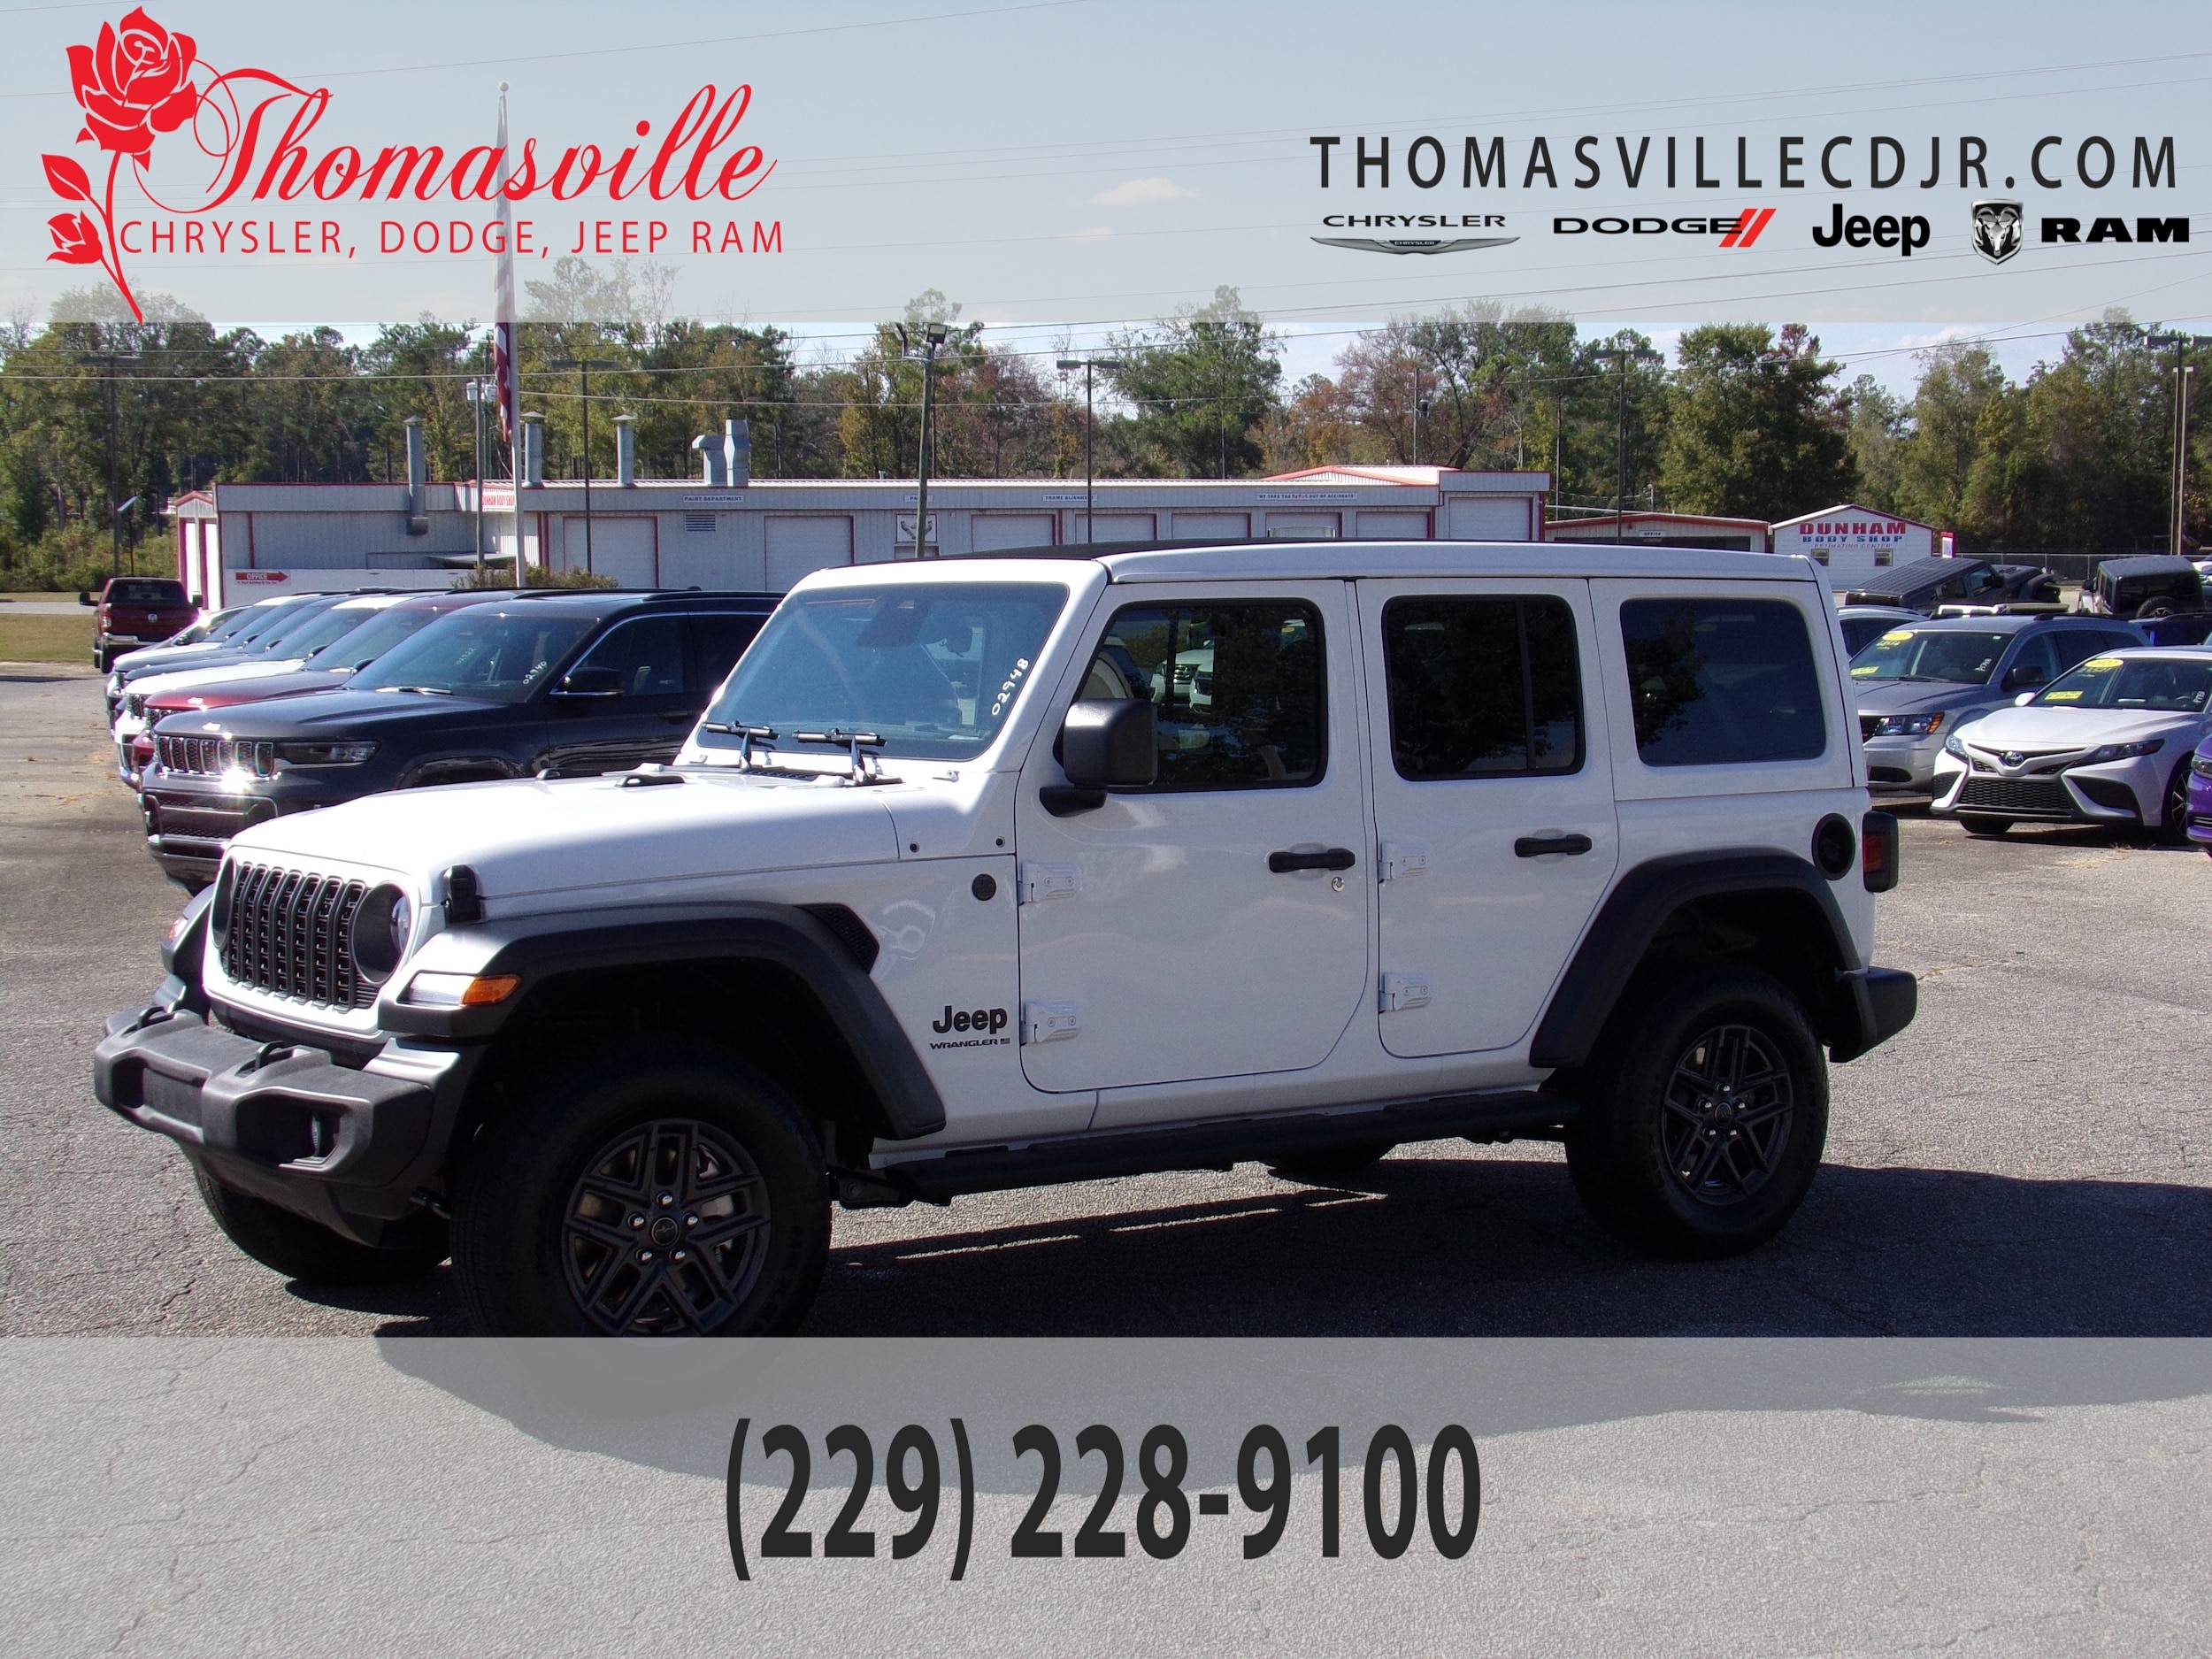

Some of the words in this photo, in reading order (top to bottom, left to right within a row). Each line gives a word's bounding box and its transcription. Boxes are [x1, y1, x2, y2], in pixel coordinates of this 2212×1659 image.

[1799, 522, 1906, 534] DUNHAM
[932, 1004, 1008, 1035] Jeep
[929, 1038, 998, 1050] WRANGLER
